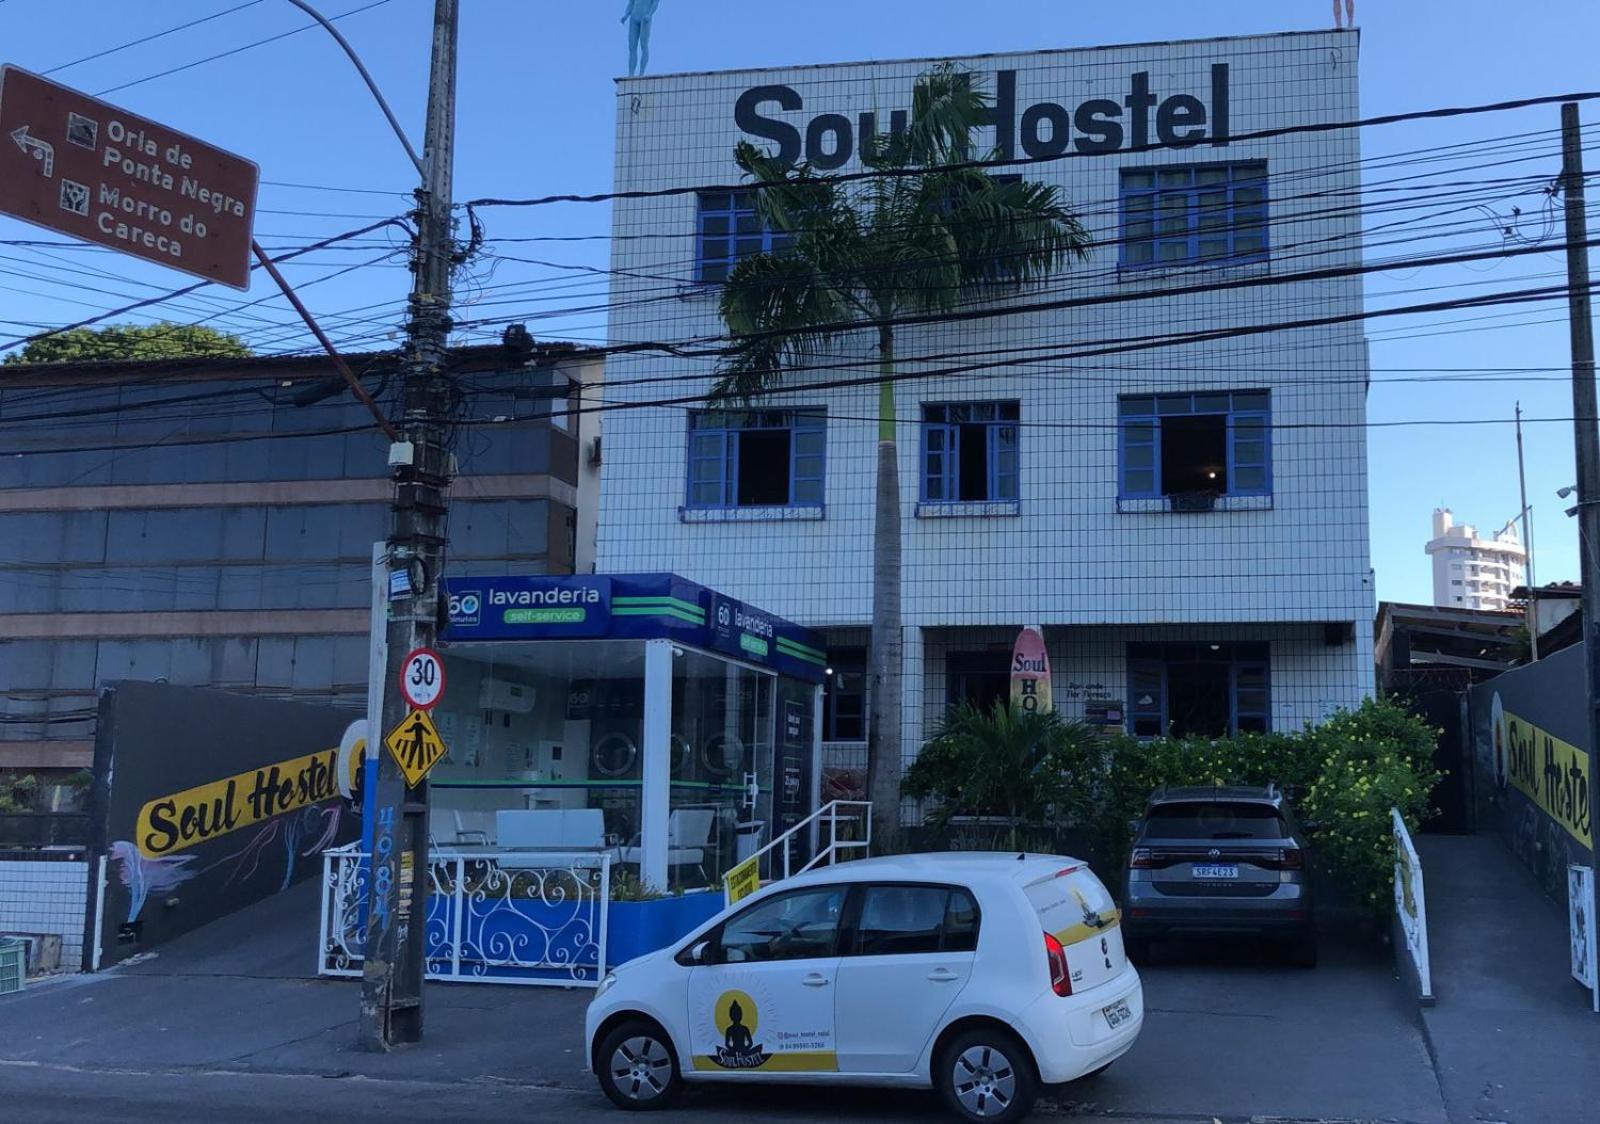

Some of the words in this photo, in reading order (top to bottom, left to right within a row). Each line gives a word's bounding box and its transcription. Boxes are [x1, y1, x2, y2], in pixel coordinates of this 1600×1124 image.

[952, 62, 1231, 163] Hostel
[107, 120, 157, 157] Orla
[165, 144, 193, 170] de
[102, 146, 174, 191] Ponta
[180, 175, 245, 217] Negra
[97, 211, 182, 257] Careca
[99, 183, 172, 226] Morro
[180, 213, 207, 238] do
[488, 586, 600, 606] lavanderia
[510, 610, 581, 622] self-service
[718, 605, 730, 626] 60
[734, 607, 774, 638] lavanderia
[411, 657, 435, 687] 30
[1013, 652, 1048, 673] Soul
[1509, 720, 1540, 796] Soul
[145, 779, 242, 853] Soul
[247, 750, 338, 819] Hostel
